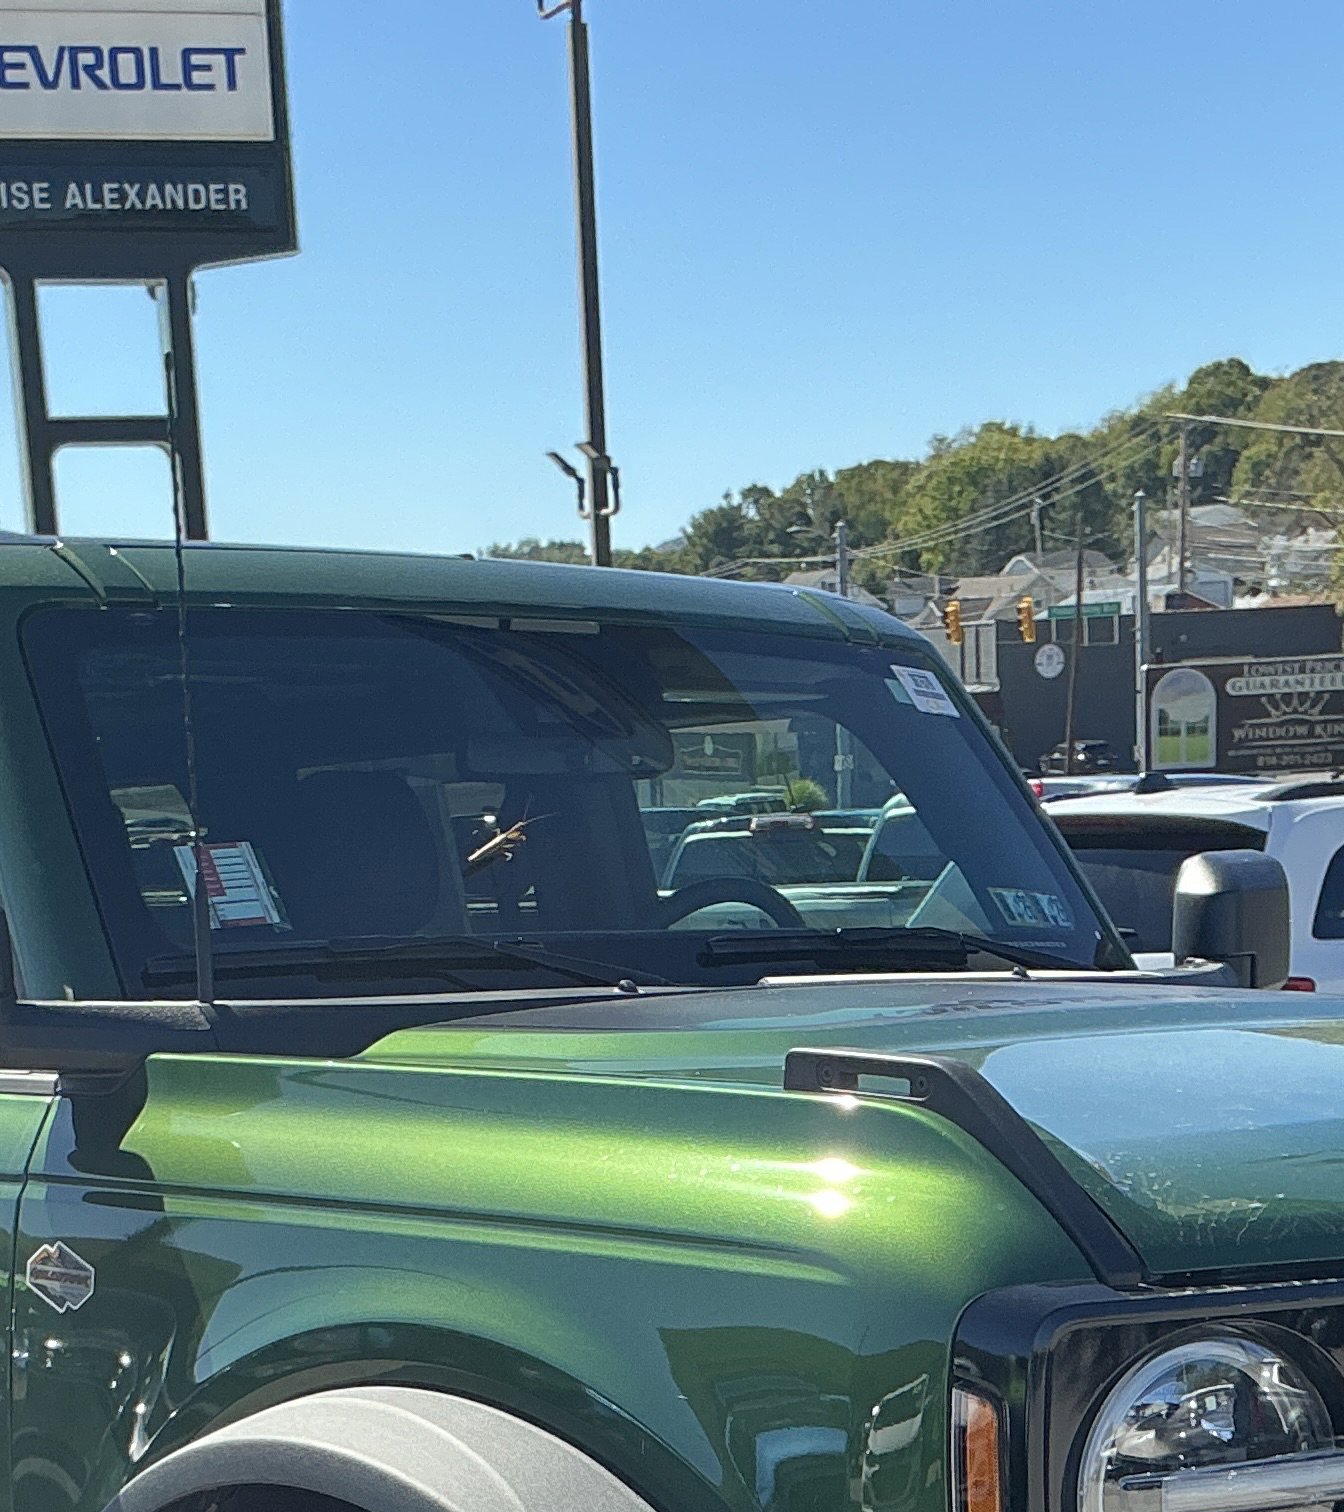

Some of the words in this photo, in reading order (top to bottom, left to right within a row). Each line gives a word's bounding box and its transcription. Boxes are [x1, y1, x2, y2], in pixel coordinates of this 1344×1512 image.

[64, 182, 249, 211] ALEXANDER
[1243, 662, 1301, 677] LOWEST
[1231, 724, 1311, 743] WINDOW
